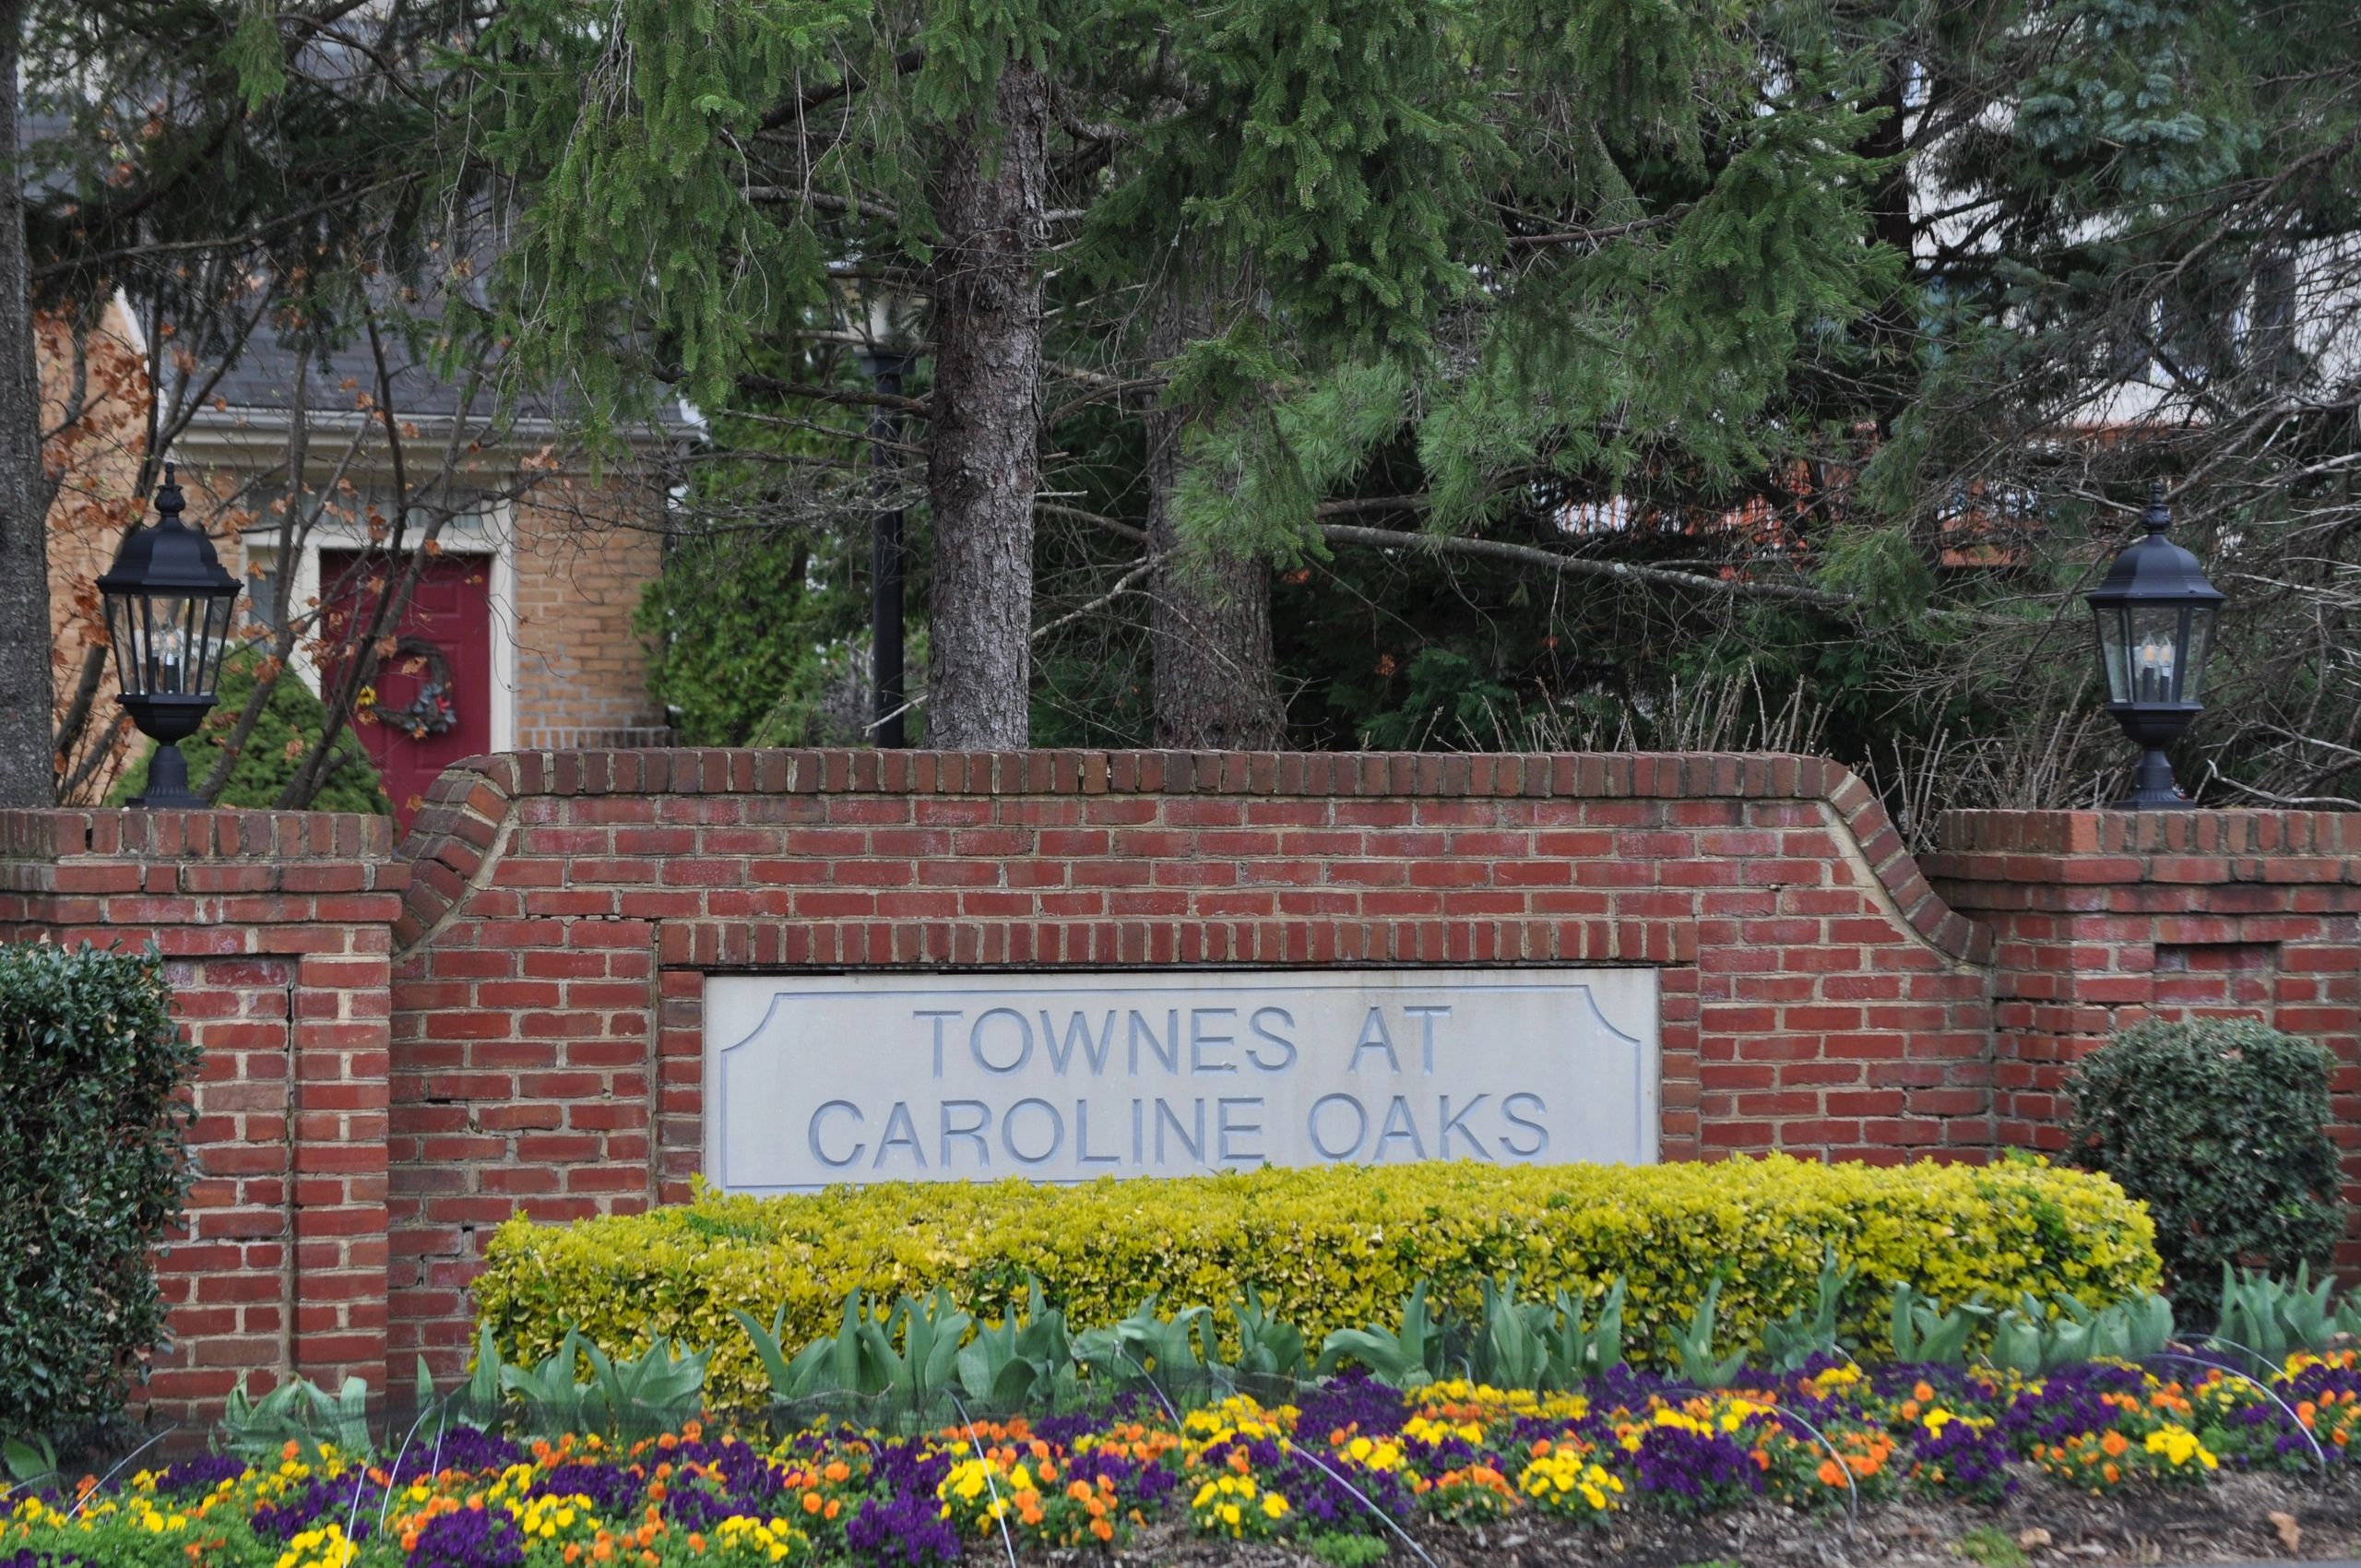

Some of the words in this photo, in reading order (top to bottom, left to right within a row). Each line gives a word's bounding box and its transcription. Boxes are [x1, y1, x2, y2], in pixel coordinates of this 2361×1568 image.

[913, 1005, 1298, 1079] TOWNES
[1347, 1004, 1453, 1076] AT
[808, 1096, 1265, 1170] CAROLINE
[1306, 1091, 1550, 1163] OAKS
